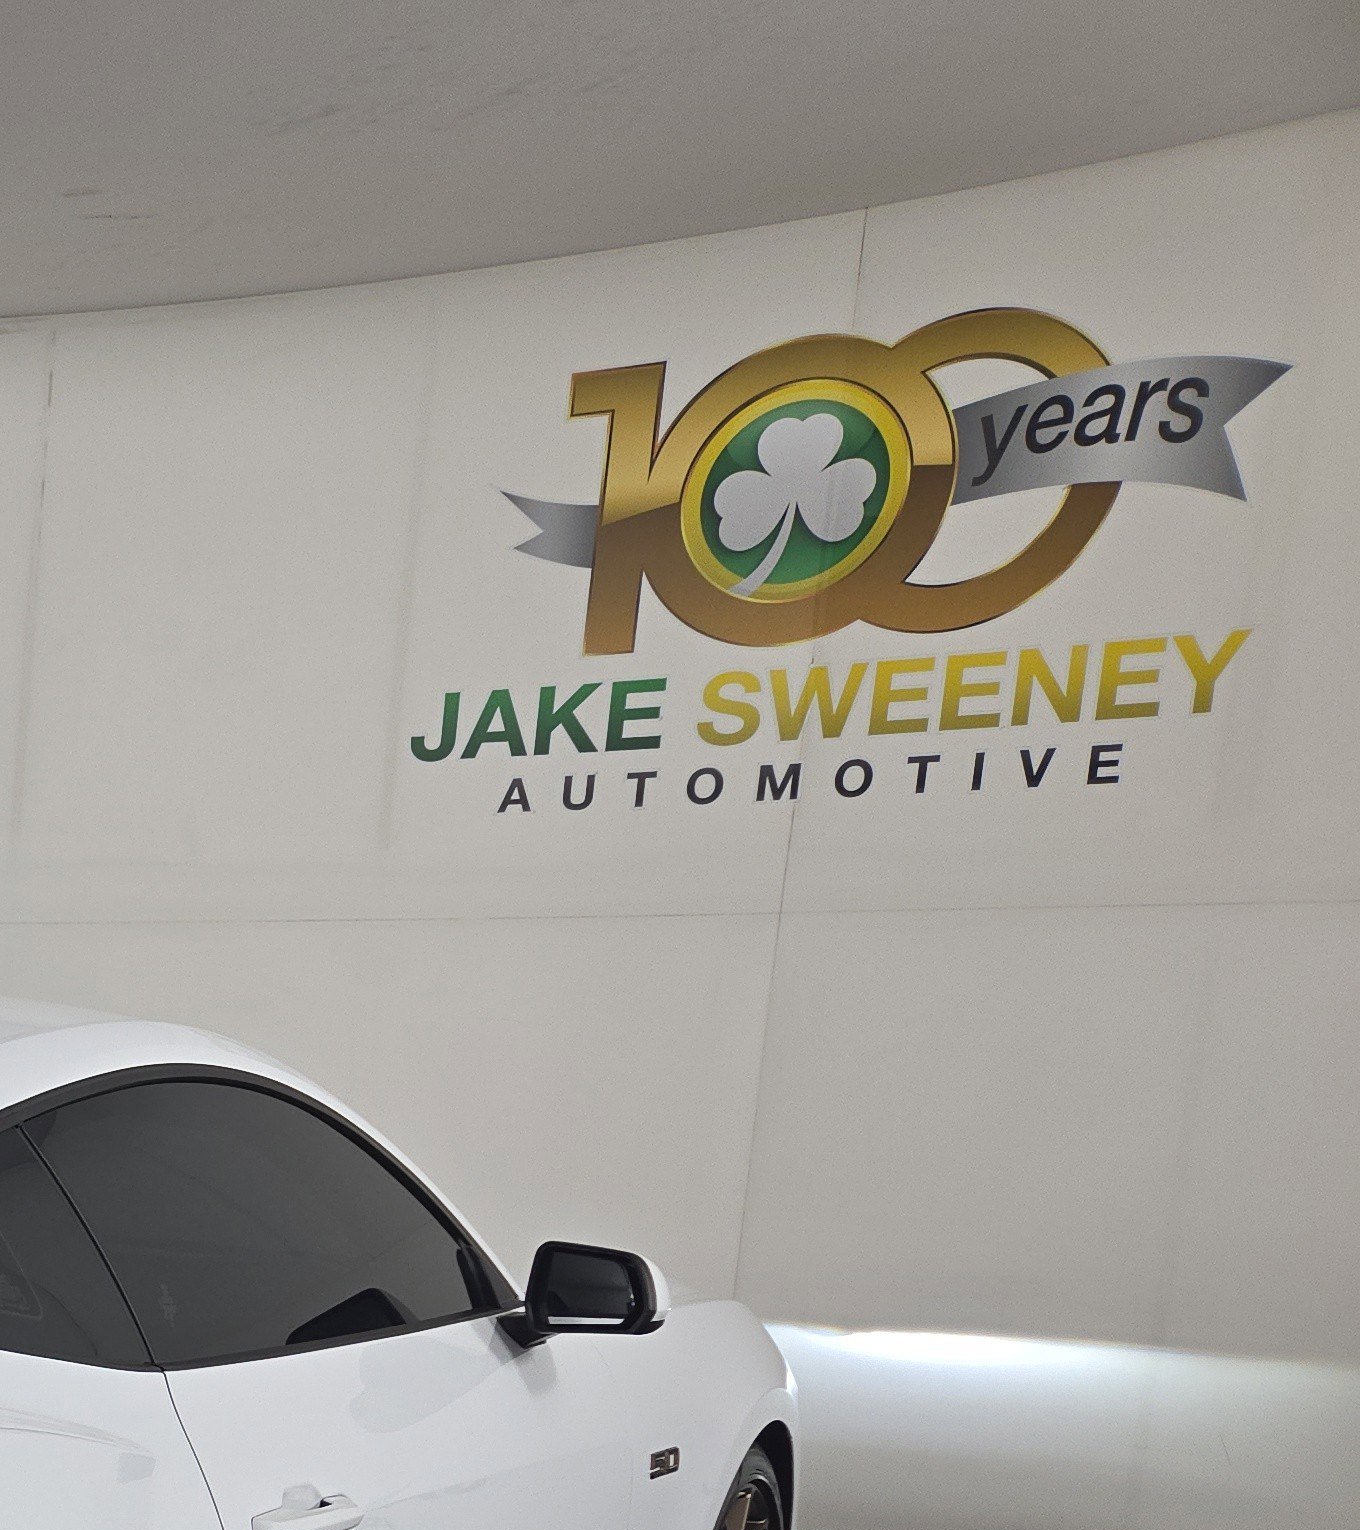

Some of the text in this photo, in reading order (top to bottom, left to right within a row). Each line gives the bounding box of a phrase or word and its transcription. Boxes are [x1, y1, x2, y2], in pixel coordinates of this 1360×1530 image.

[569, 307, 1211, 657] 100 years
[410, 628, 1253, 763] JAKE SWEENEY
[497, 743, 1124, 815] AUTOMOTIVE
